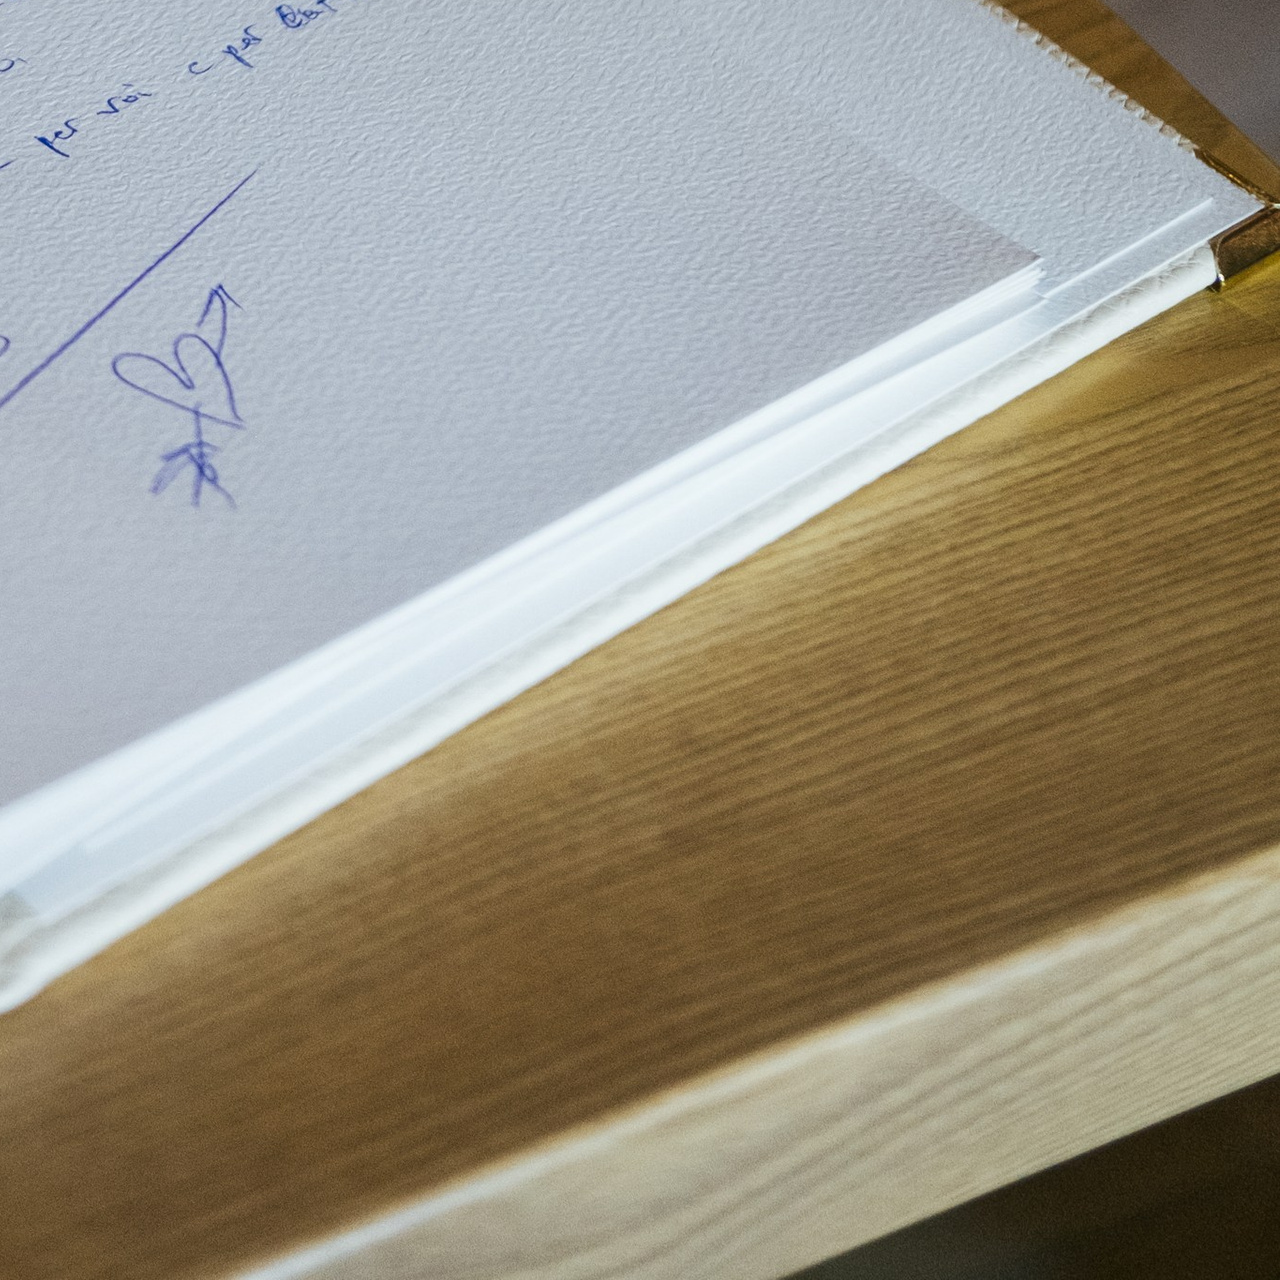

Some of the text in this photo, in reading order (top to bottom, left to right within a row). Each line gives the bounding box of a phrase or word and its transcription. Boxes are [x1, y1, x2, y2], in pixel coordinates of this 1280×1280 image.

[33, 117, 79, 159] per
[96, 82, 152, 116] voi
[222, 24, 262, 69] per
